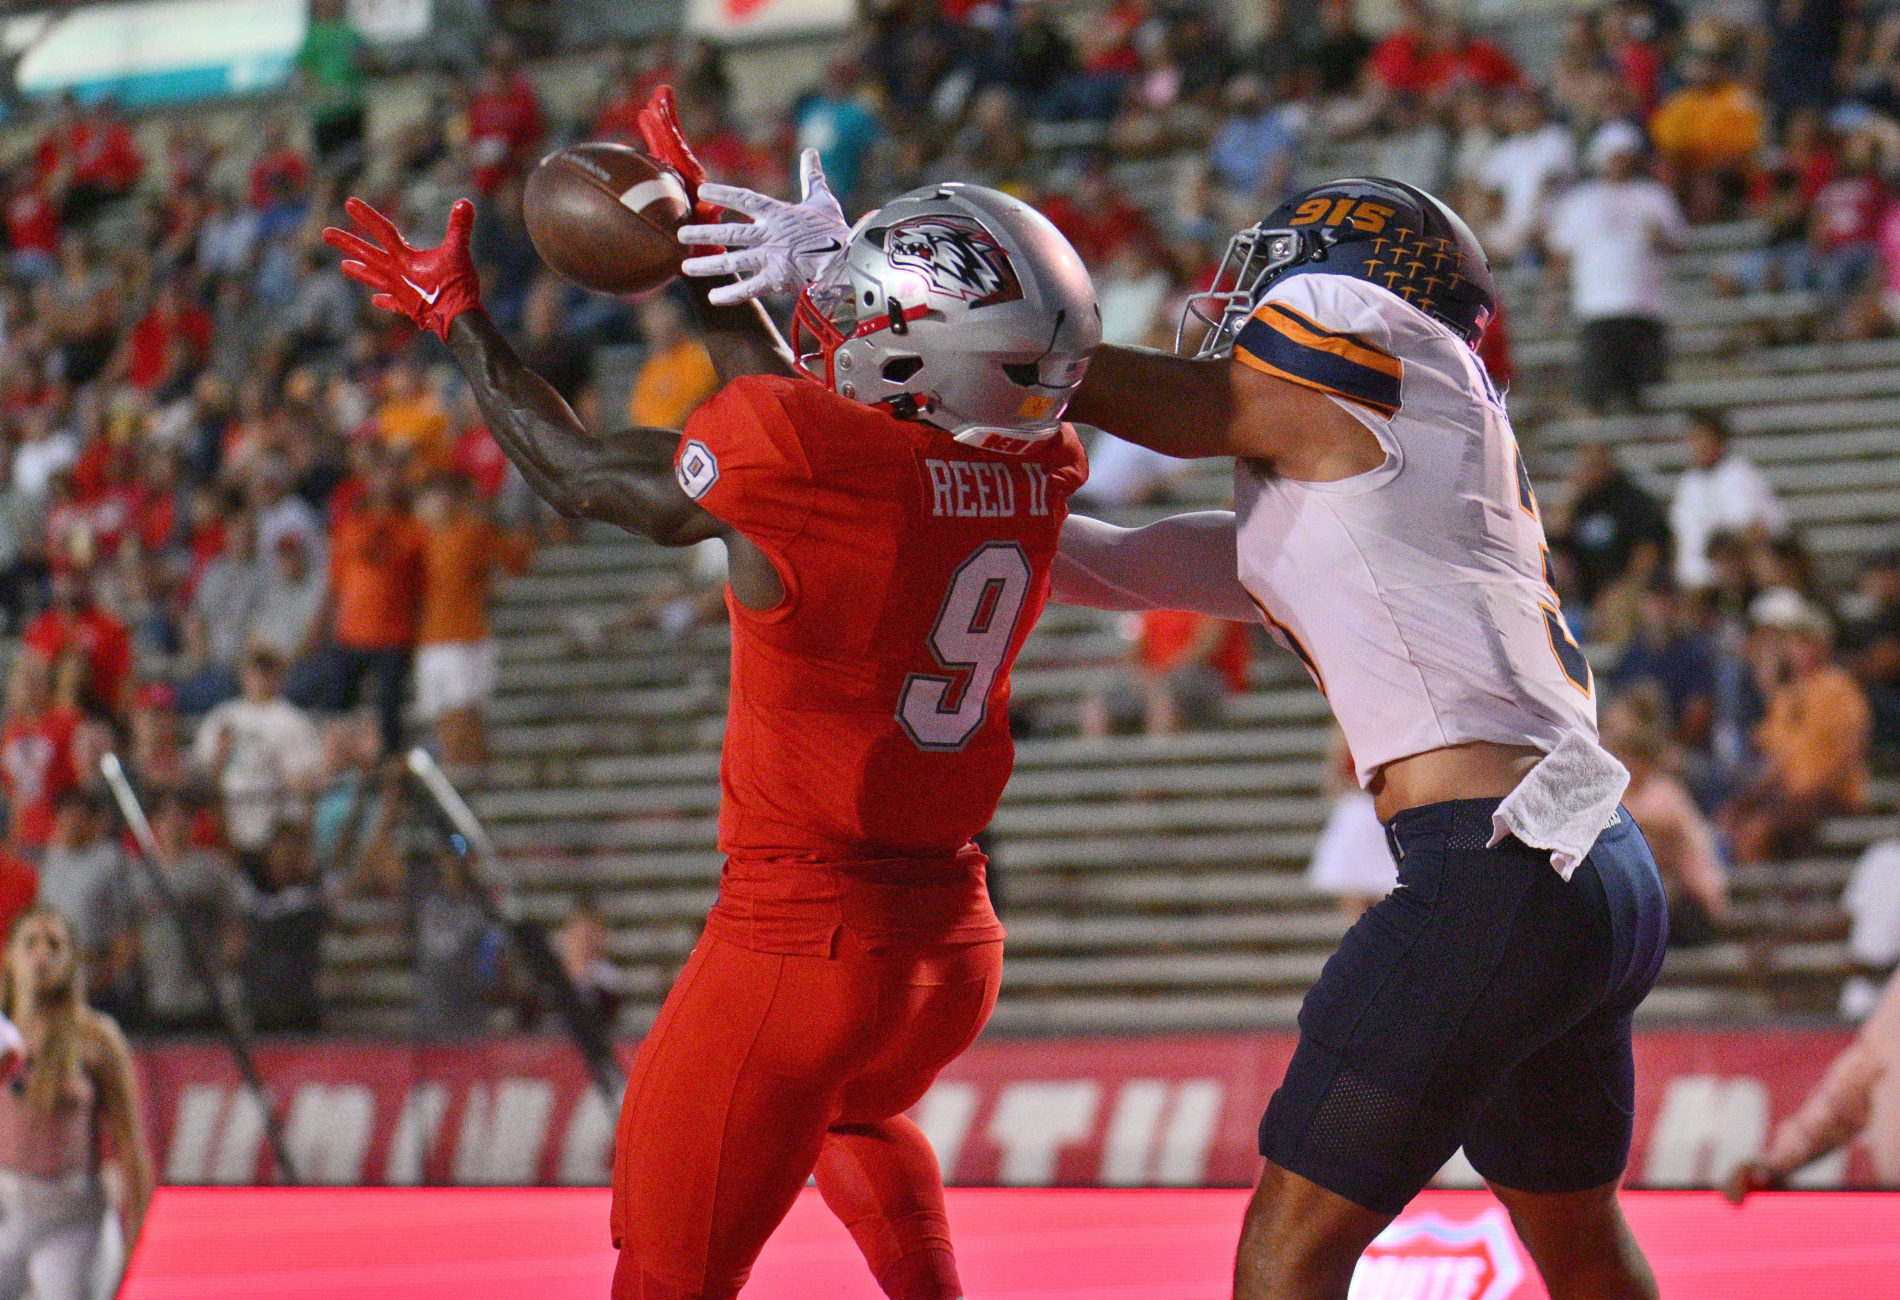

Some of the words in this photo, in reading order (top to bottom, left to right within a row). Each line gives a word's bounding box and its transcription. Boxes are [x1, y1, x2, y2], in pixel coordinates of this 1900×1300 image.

[1288, 198, 1397, 233] 915
[925, 458, 1016, 517] REED
[1021, 462, 1049, 516] II
[894, 539, 1033, 752] 9
